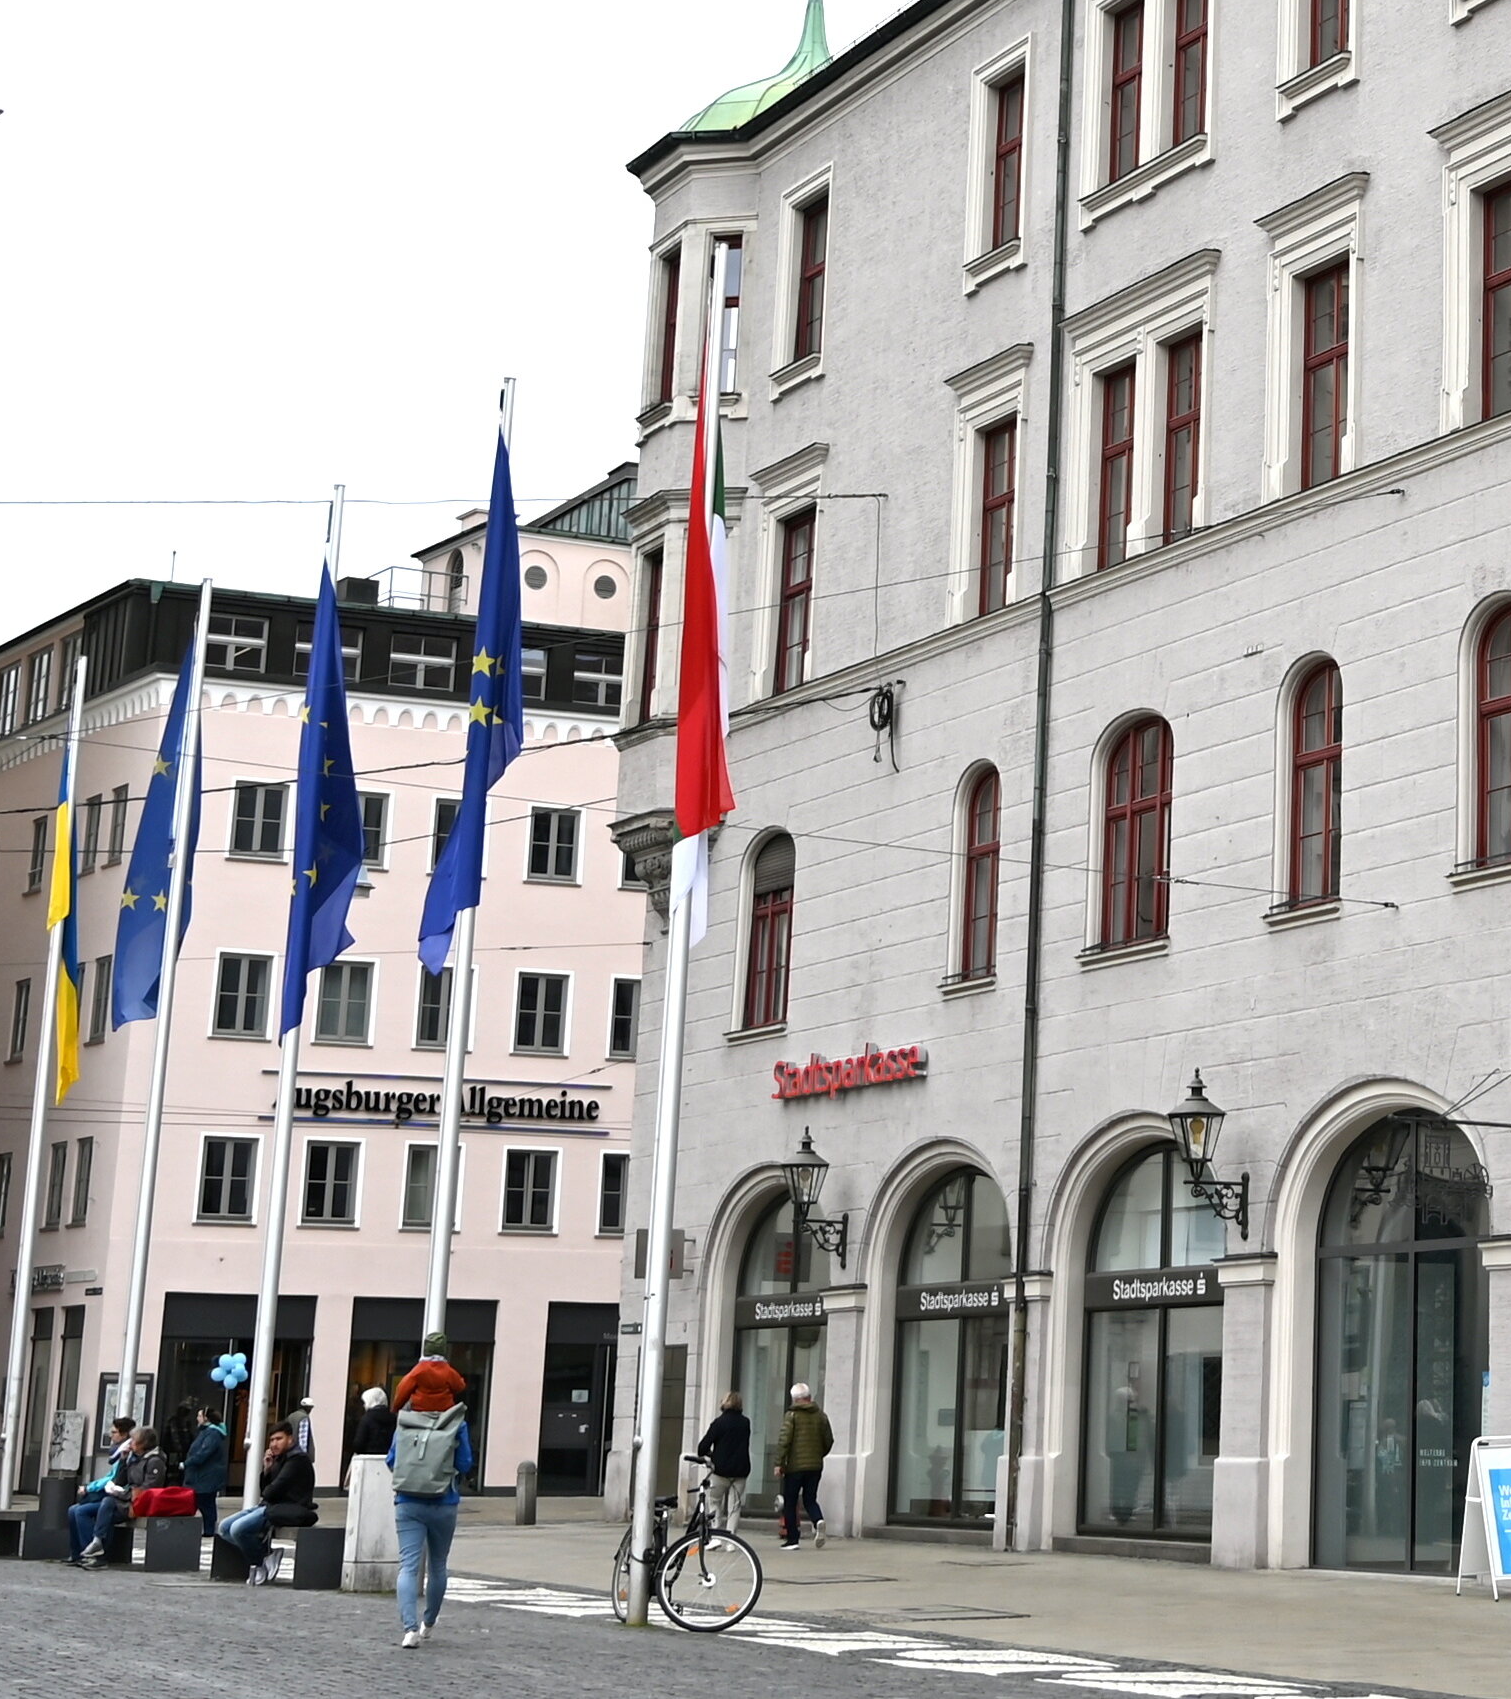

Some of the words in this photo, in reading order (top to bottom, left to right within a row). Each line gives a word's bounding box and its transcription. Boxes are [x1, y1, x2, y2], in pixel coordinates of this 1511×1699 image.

[771, 1042, 923, 1099] Stadtsparkasse
[920, 1290, 989, 1312] Stadtsparkasse
[1113, 1277, 1194, 1302] Stadtsparkasse
[755, 1301, 814, 1321] Stadtsparkasse
